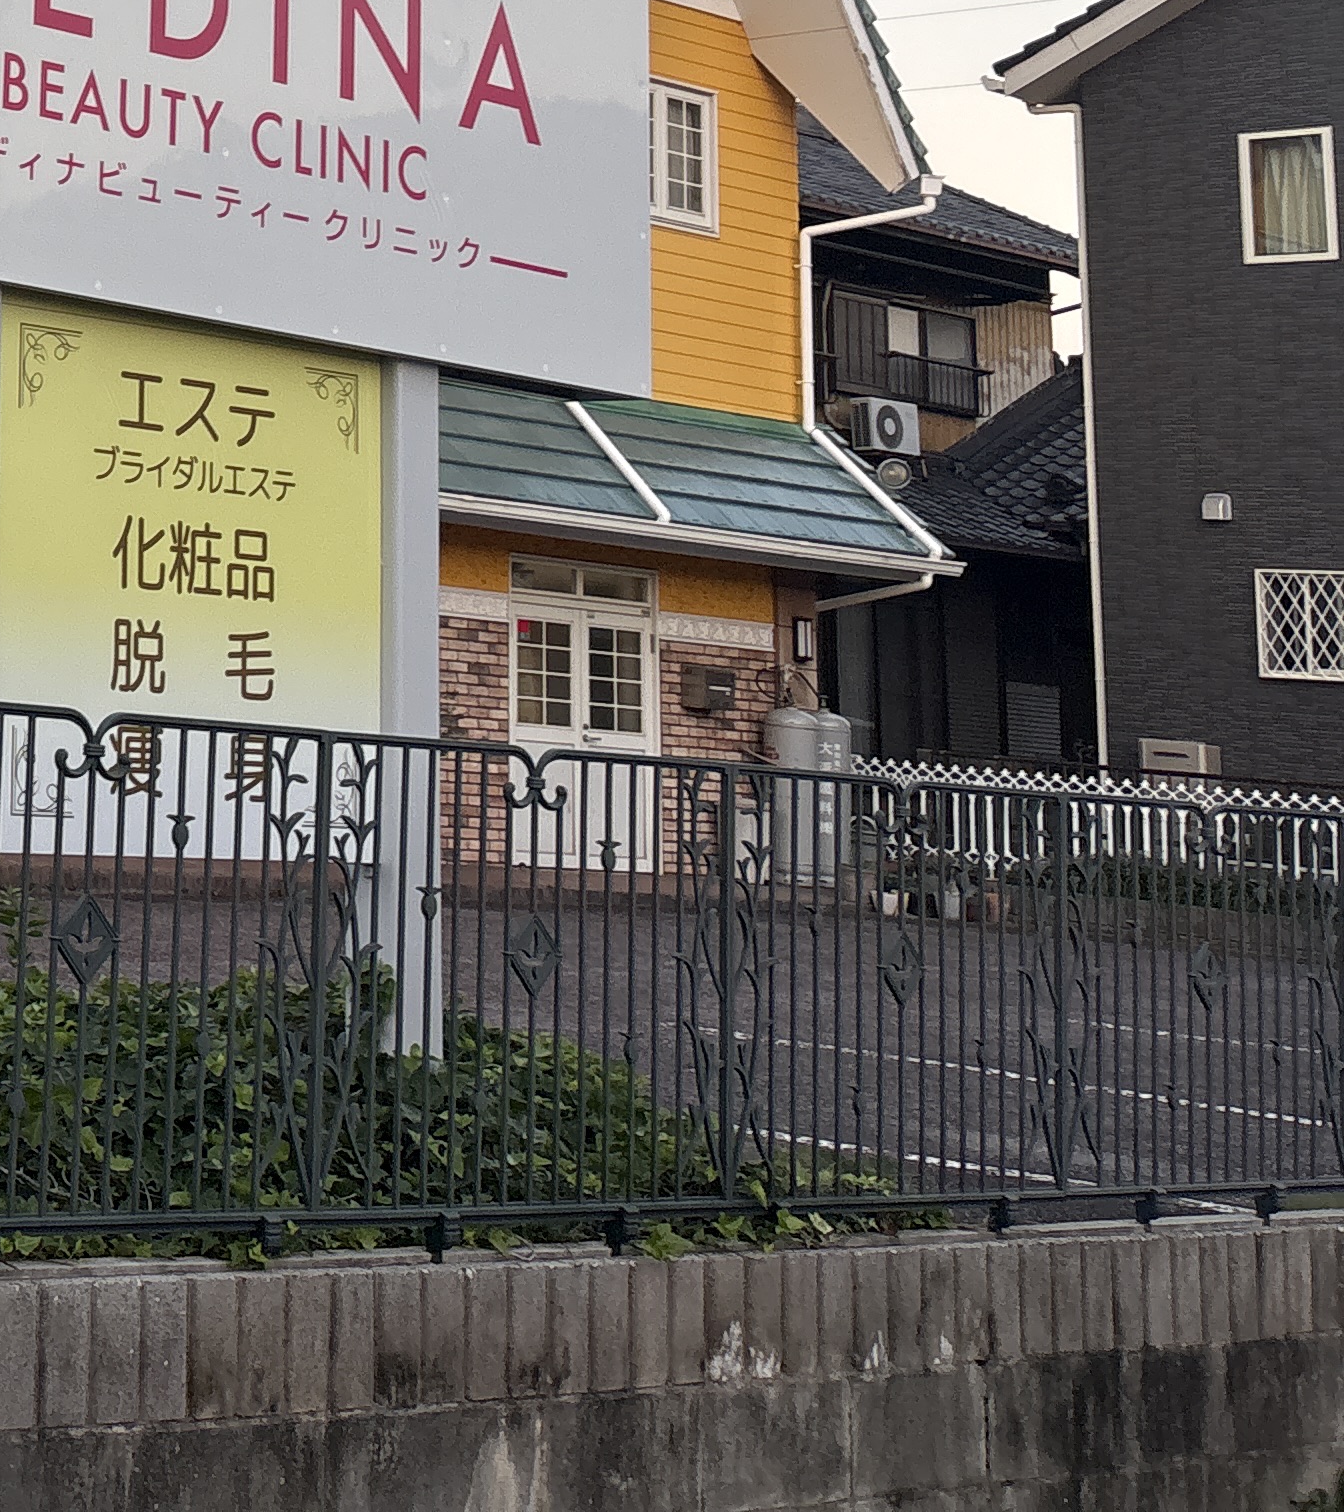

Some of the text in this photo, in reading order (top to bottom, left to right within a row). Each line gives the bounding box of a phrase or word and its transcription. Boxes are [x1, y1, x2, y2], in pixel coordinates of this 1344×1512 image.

[1, 51, 427, 201] BEAUTY CLINIC
[117, 369, 277, 448] エステ
[93, 443, 297, 503] ブライダルエステ
[112, 515, 276, 604] 化粧品
